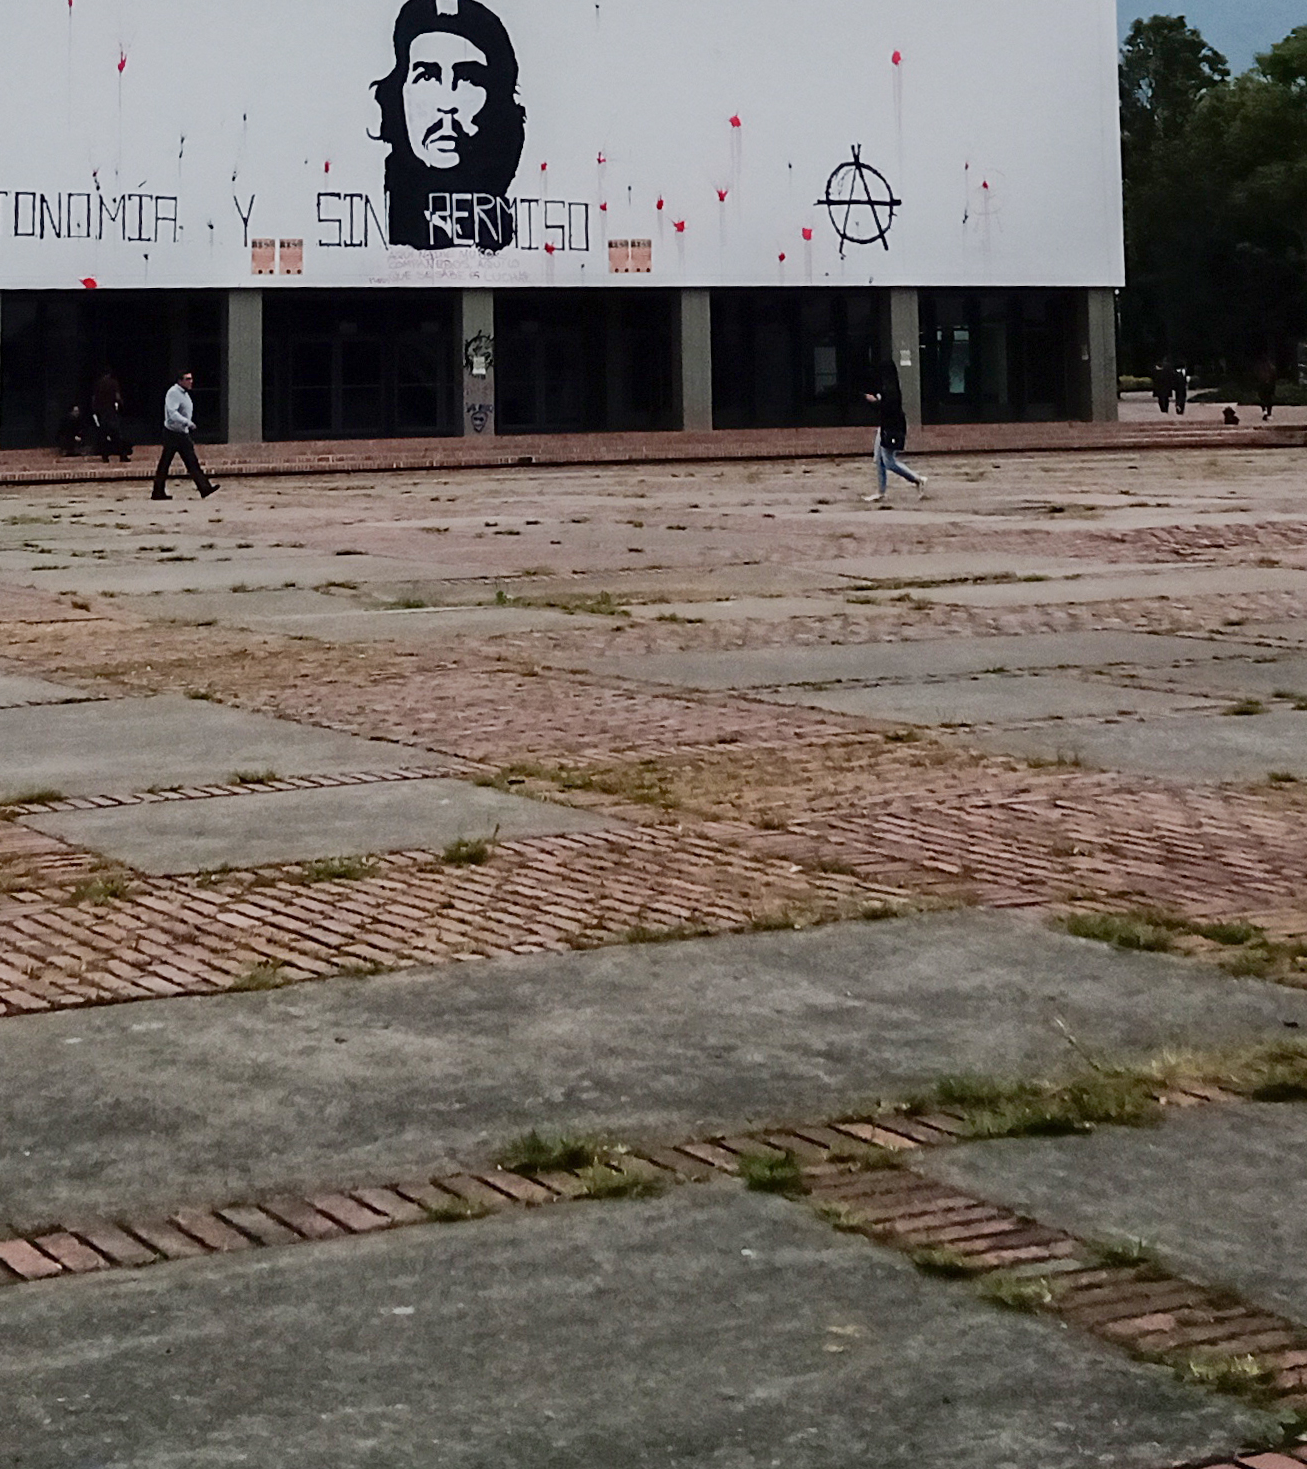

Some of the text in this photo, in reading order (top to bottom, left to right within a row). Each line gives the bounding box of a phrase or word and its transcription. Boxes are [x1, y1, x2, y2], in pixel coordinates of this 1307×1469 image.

[233, 194, 256, 248] Y
[316, 191, 391, 251] SIN
[428, 192, 590, 252] PERMISO
